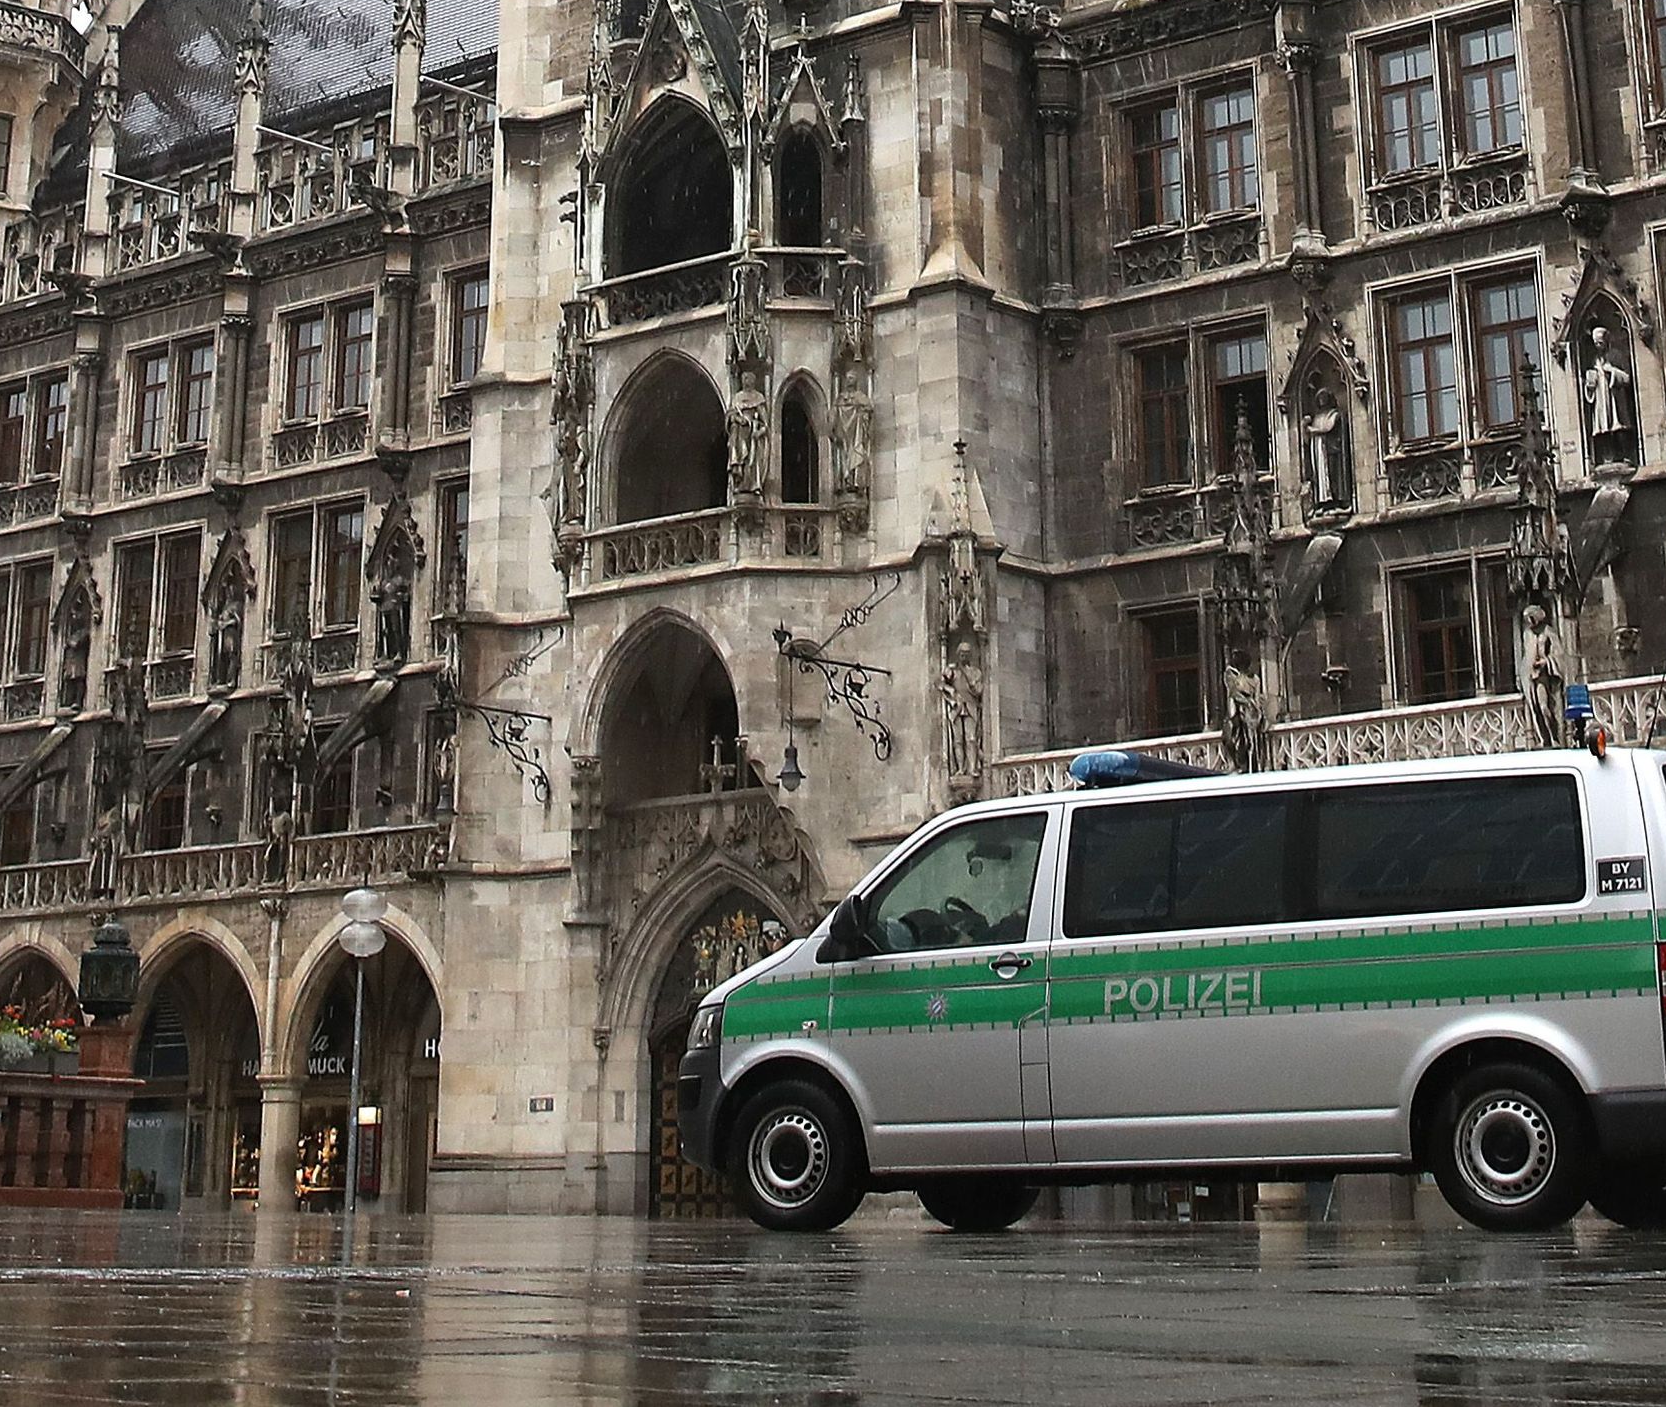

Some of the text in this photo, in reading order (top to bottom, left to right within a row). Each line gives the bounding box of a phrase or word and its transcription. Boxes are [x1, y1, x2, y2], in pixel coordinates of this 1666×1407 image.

[1612, 862, 1630, 874] BY
[1601, 877, 1642, 891] M 7121
[1104, 970, 1262, 1014] POLIZEI
